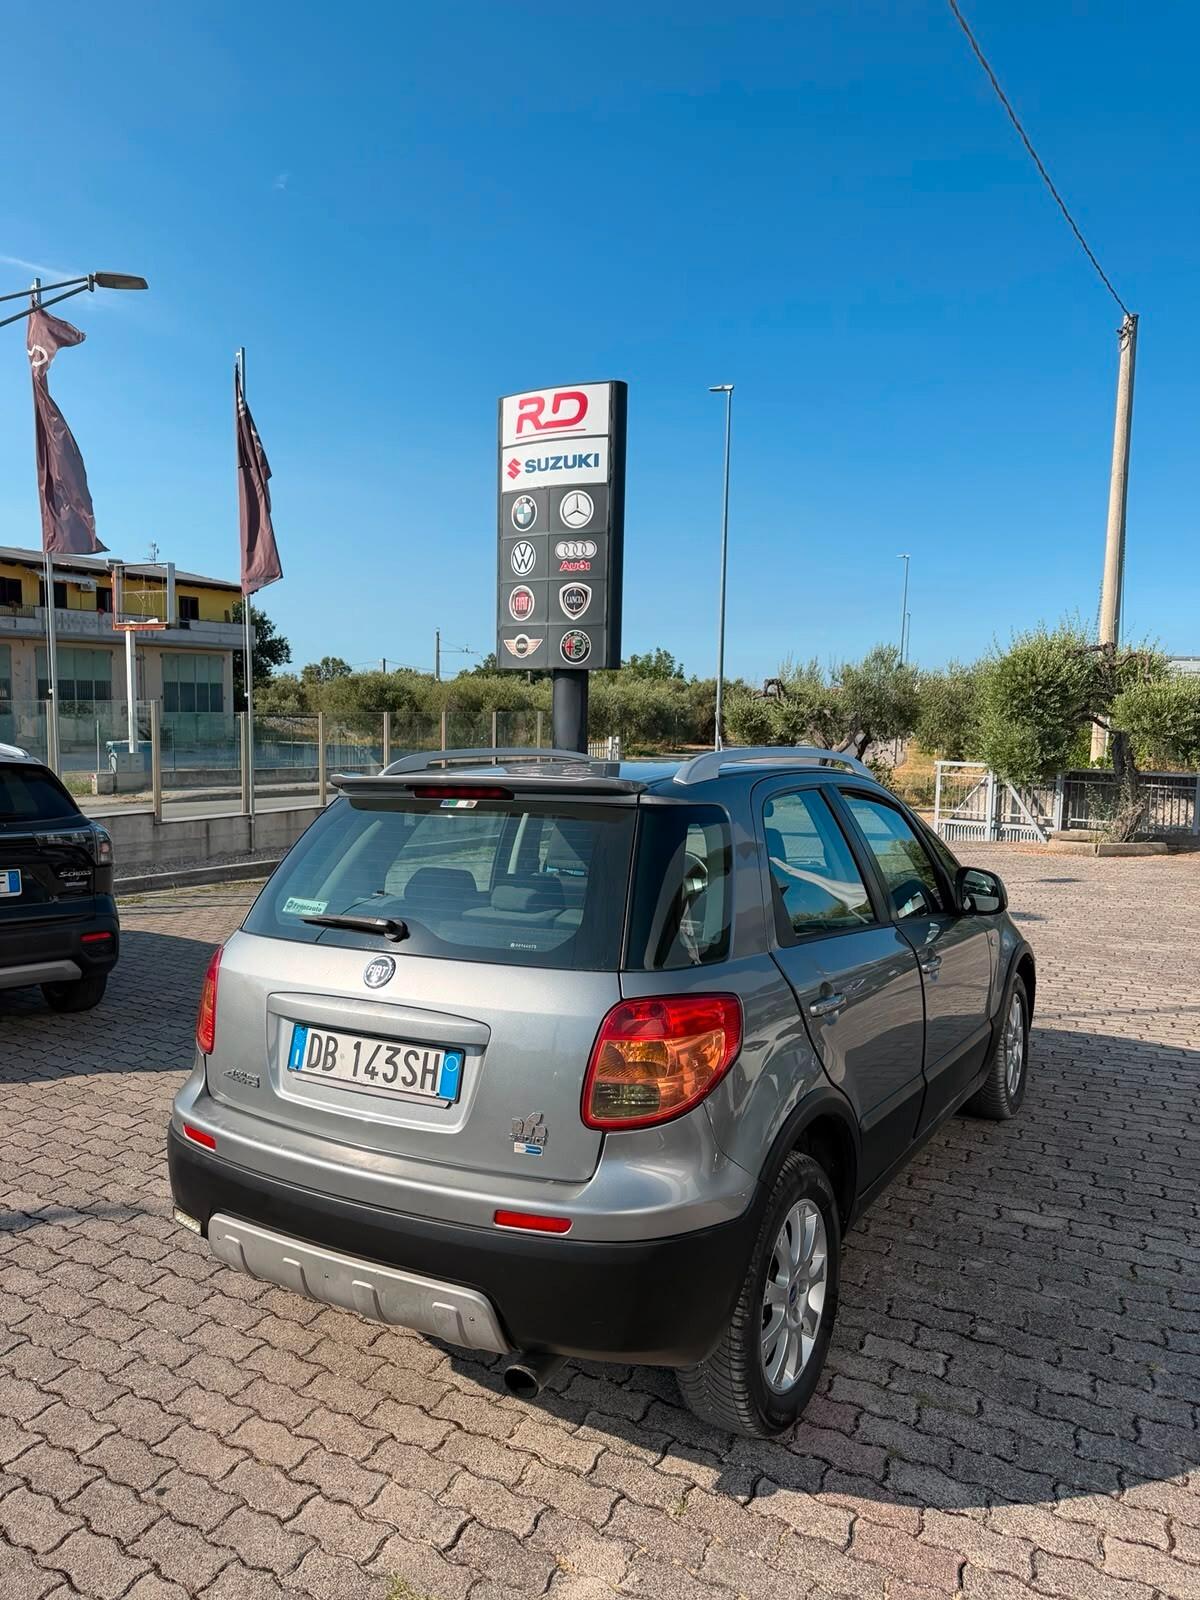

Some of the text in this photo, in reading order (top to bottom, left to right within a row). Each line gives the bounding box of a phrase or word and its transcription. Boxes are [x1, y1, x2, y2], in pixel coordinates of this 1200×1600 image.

[516, 391, 588, 434] RD
[525, 453, 600, 473] SUZUKI
[559, 560, 591, 571] Audi
[367, 964, 389, 977] FIAT
[306, 1032, 441, 1091] DB 143SH
